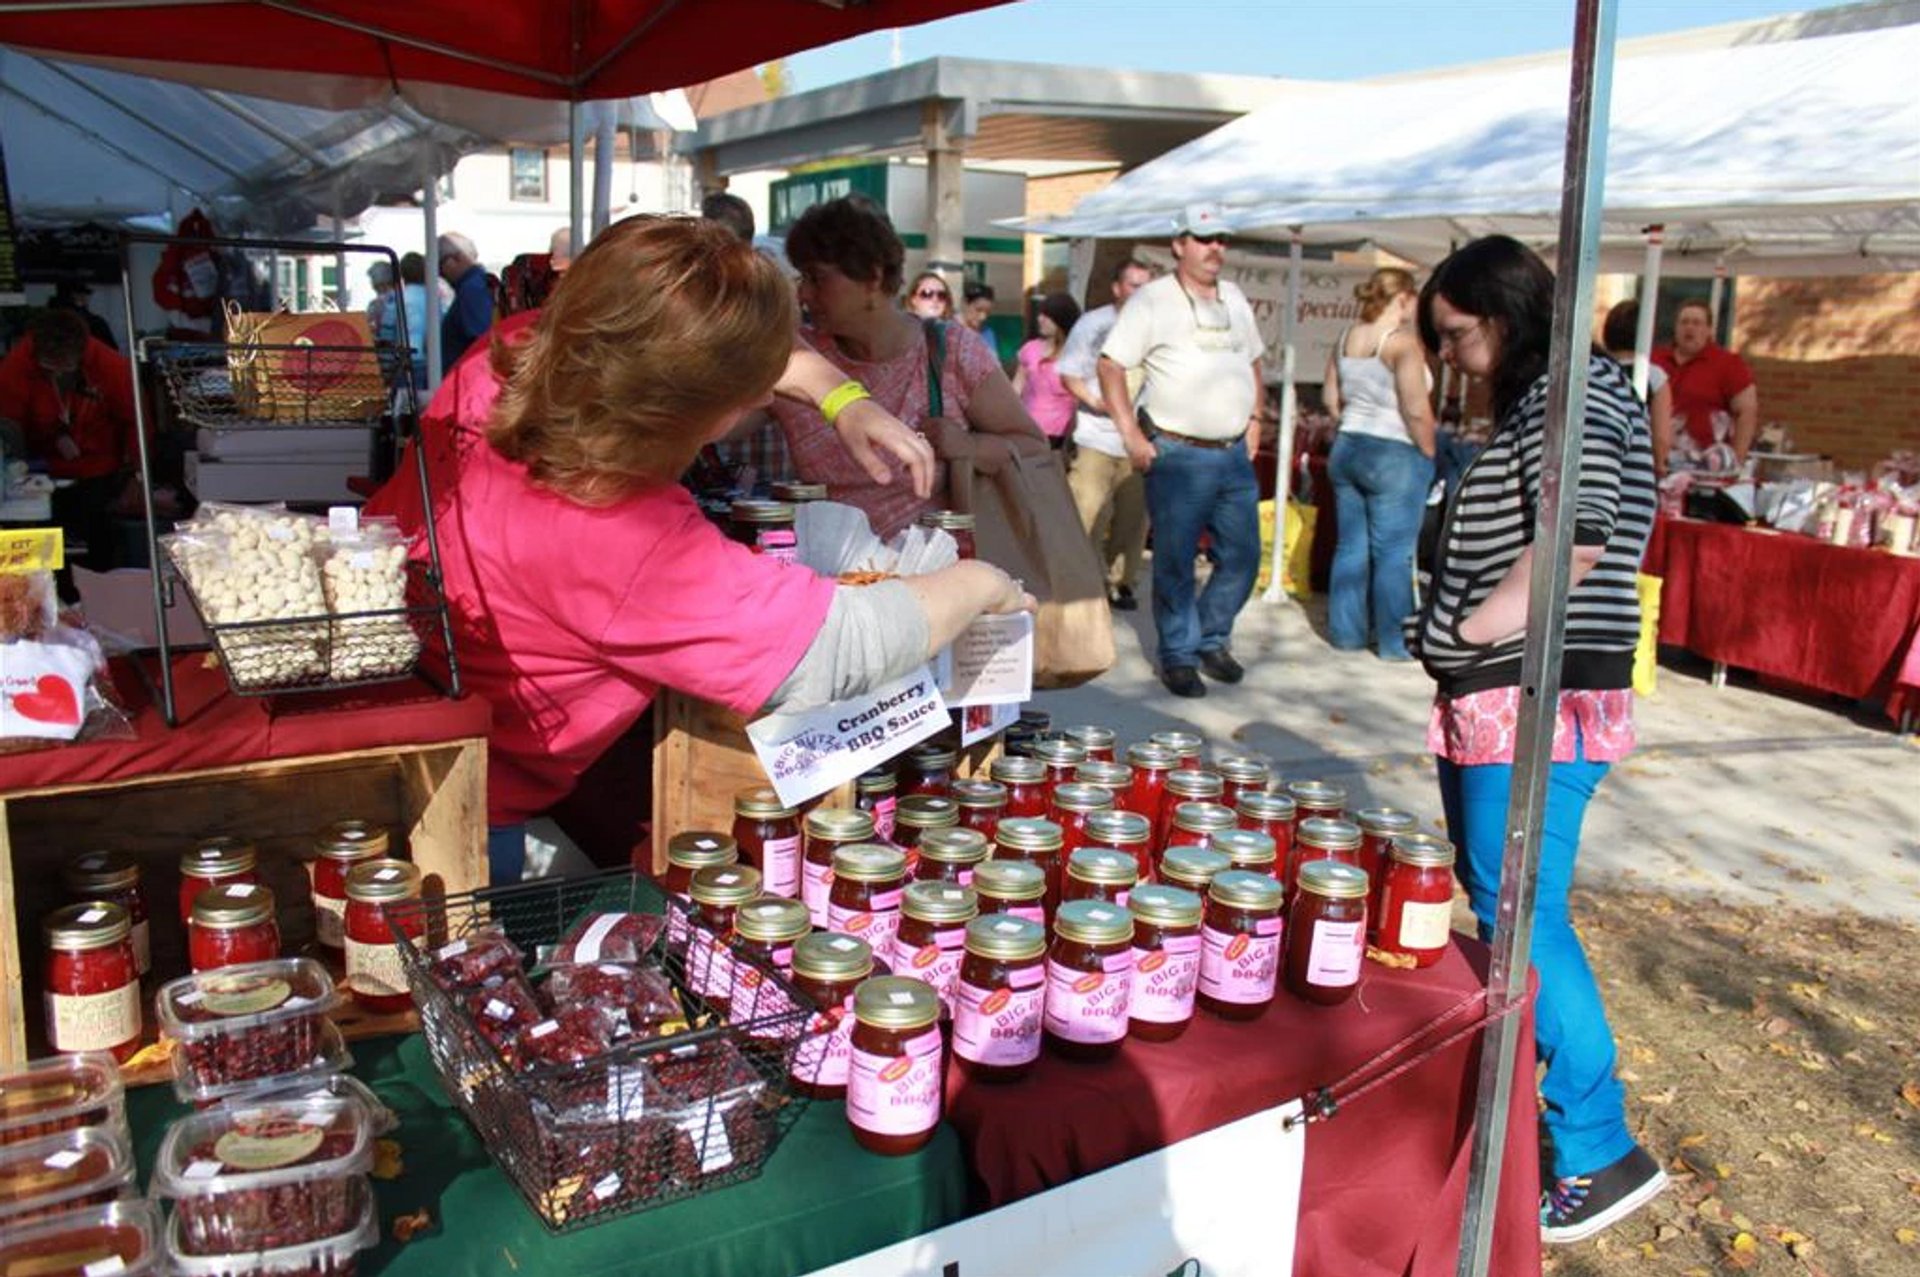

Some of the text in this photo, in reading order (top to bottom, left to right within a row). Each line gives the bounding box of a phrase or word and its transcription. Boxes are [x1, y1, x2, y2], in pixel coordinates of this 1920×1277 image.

[837, 681, 926, 733] Cranberry
[847, 725, 885, 753] BBQ
[886, 699, 937, 732] Sauce
[774, 745, 795, 771] BIG
[1237, 948, 1265, 969] BIG
[922, 961, 952, 983] BIG
[1151, 964, 1180, 987] BIG
[1087, 983, 1117, 1007] BIG
[995, 1003, 1026, 1028] BIG
